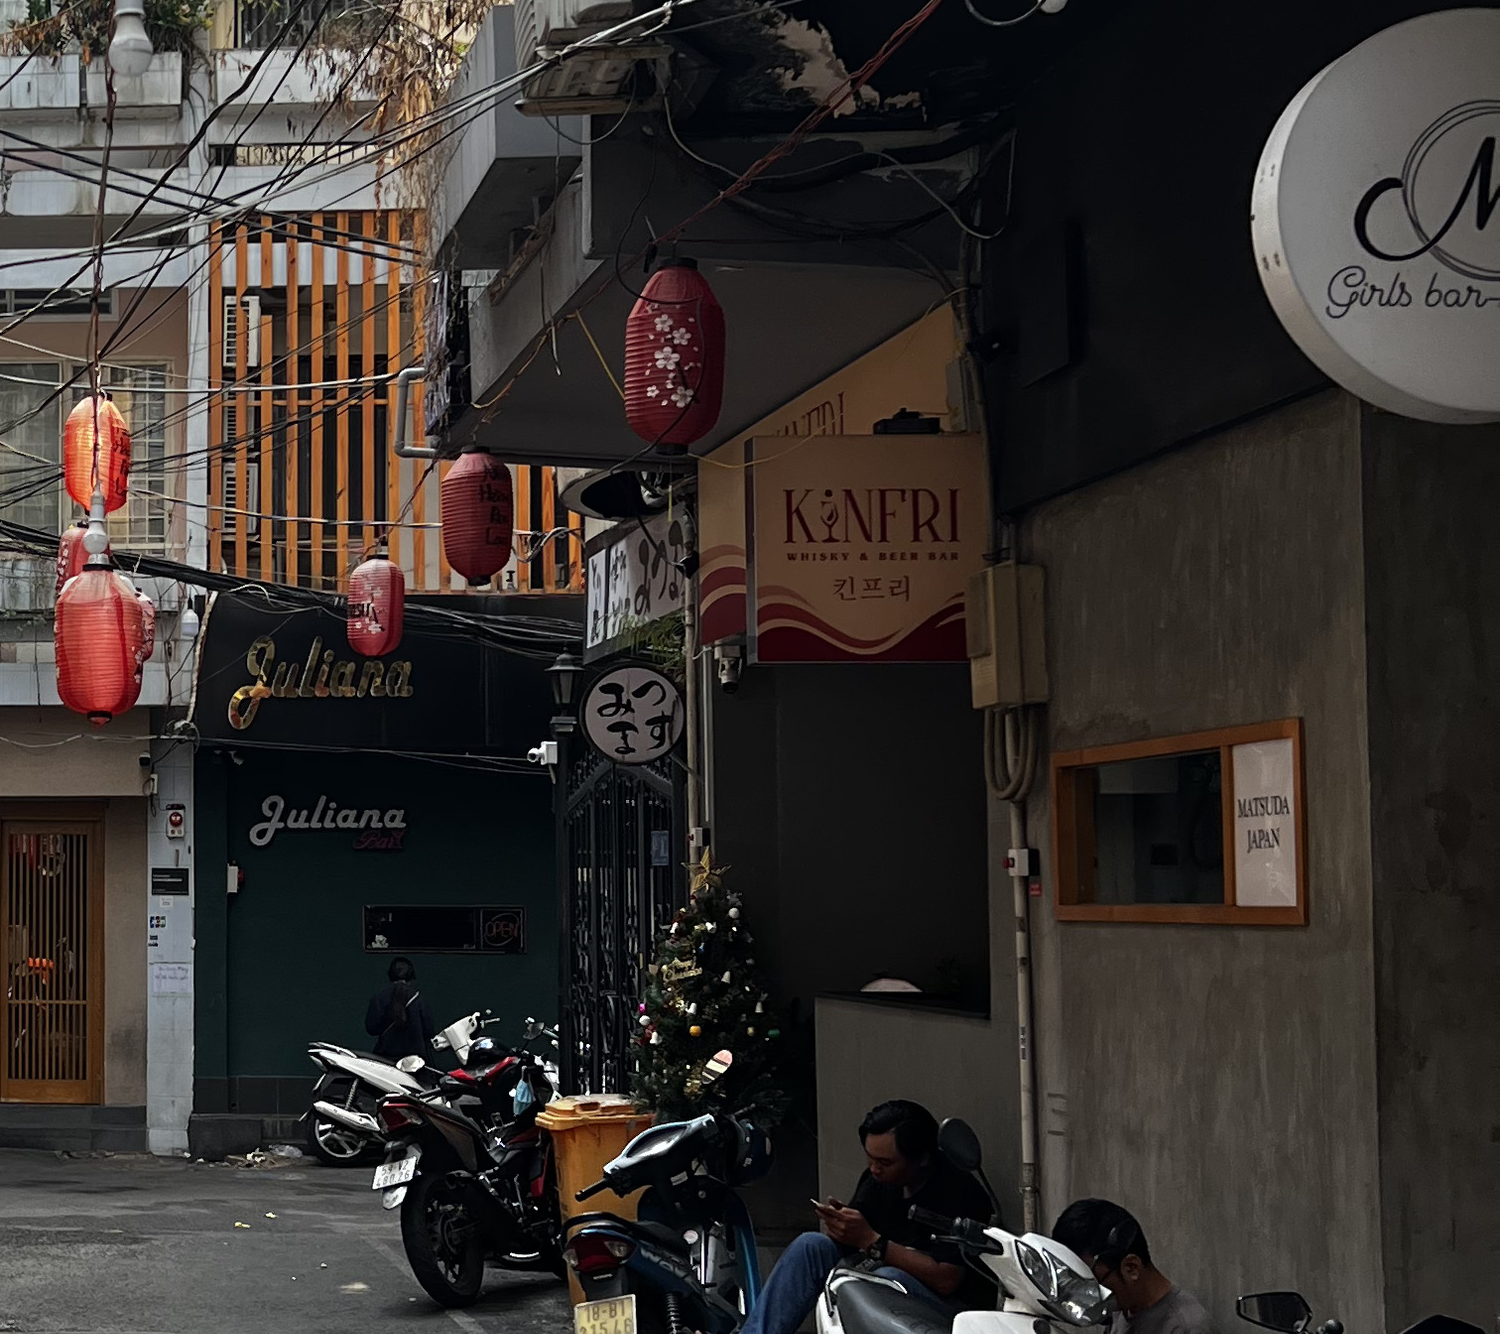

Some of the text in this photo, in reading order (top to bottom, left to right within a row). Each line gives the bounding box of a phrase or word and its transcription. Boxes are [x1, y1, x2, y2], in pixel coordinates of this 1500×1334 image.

[1326, 266, 1412, 318] Girls
[786, 552, 959, 561] WHISKY & BEER BAR
[833, 575, 911, 602] 킨프리
[228, 635, 414, 729] Juliana
[1237, 795, 1290, 818] MATSUDA
[249, 795, 407, 846] Juliana
[1247, 828, 1281, 853] JAPAN
[485, 921, 519, 938] OPEN
[586, 1301, 626, 1322] 18-B1
